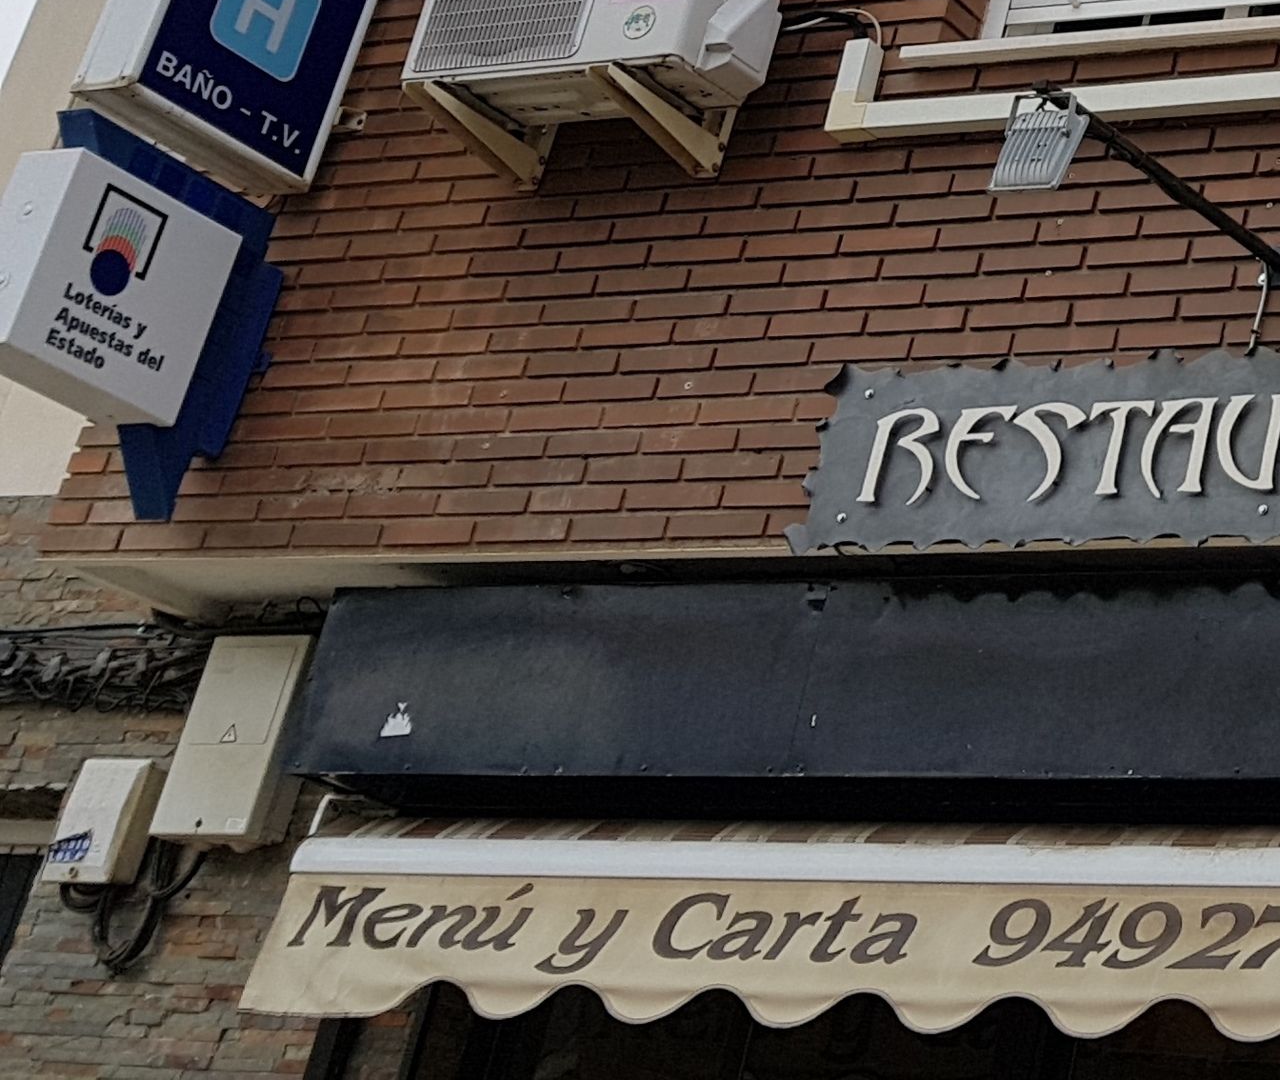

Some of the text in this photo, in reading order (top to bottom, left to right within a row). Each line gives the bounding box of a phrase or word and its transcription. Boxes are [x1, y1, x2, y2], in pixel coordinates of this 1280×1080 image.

[156, 50, 233, 110] BAÑO
[261, 110, 300, 154] T.V.
[54, 307, 165, 372] Apuestas del
[63, 282, 148, 340] Loterías y
[45, 327, 105, 369] Estado
[286, 882, 536, 952] Menú
[533, 907, 630, 975] y
[651, 892, 919, 966] Carta
